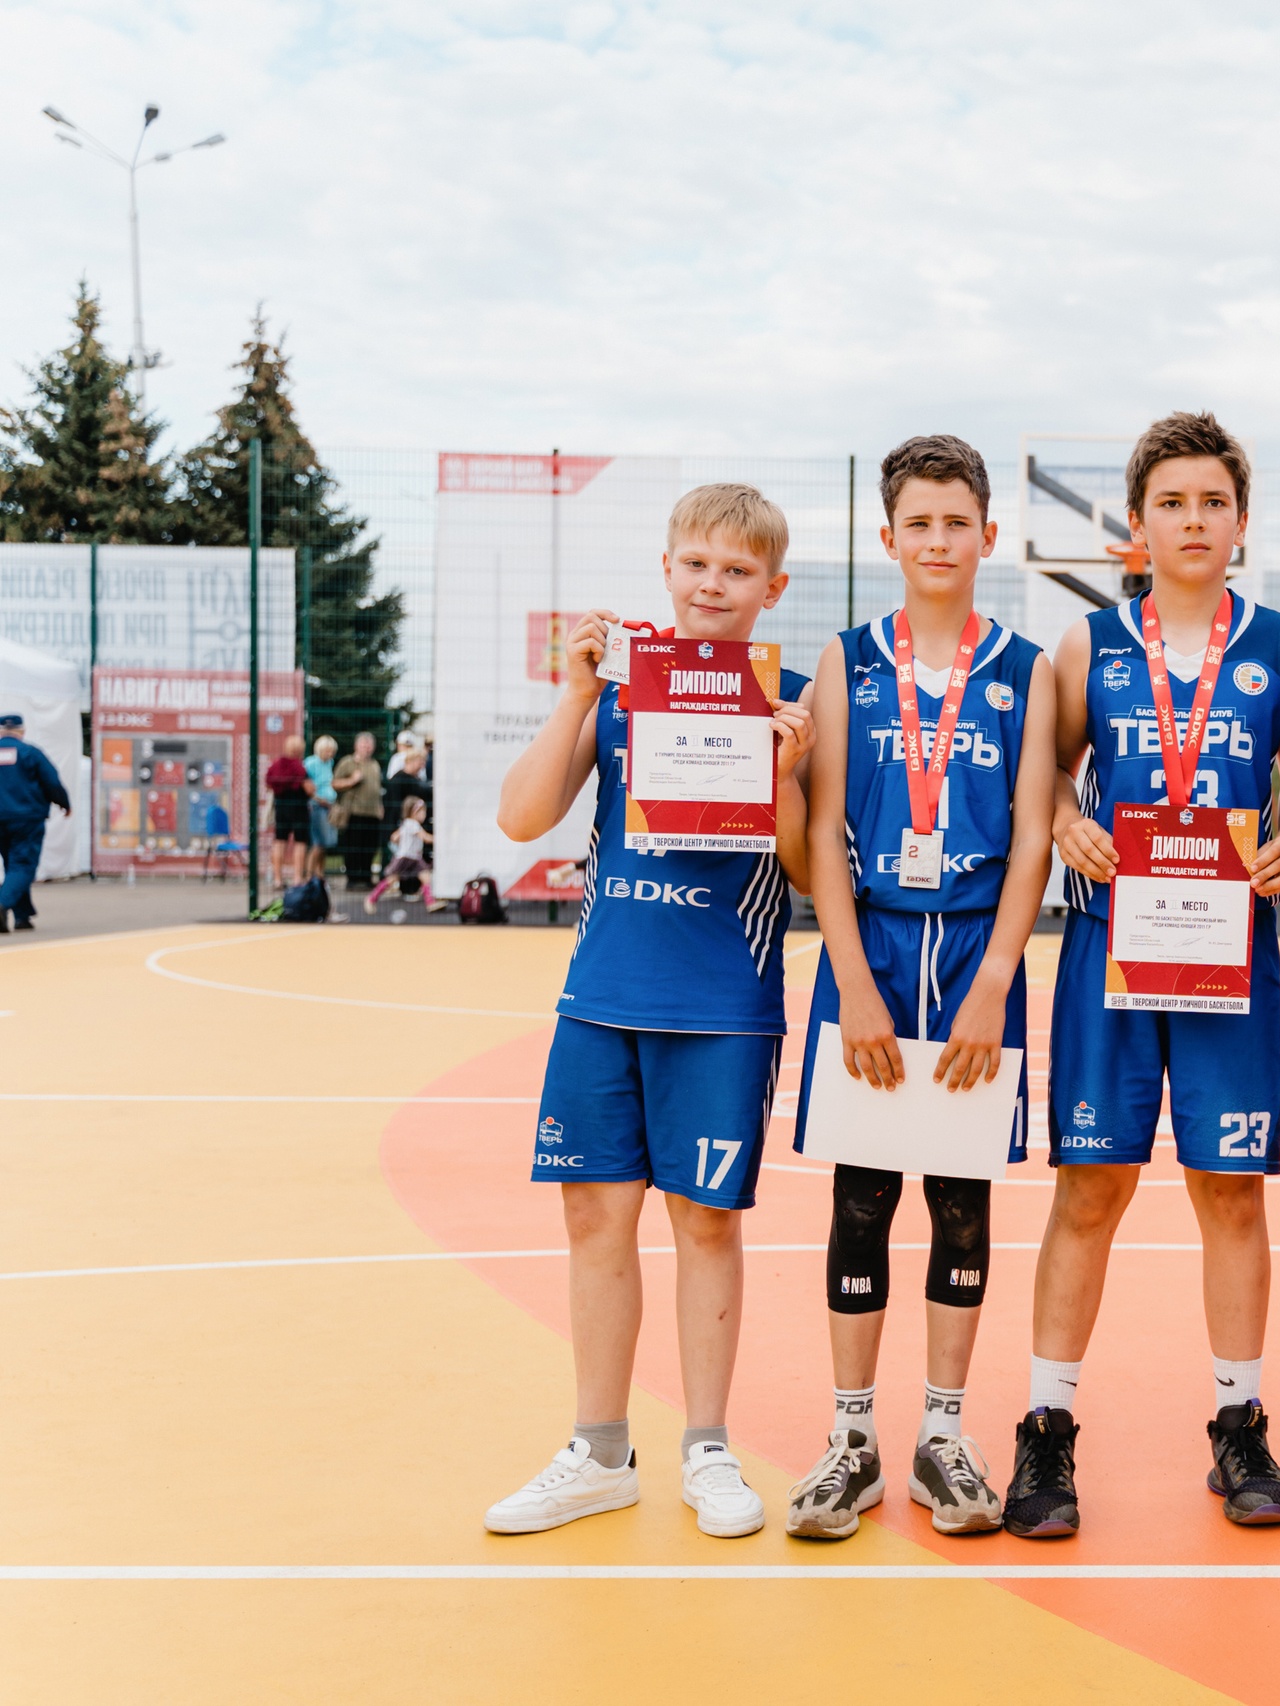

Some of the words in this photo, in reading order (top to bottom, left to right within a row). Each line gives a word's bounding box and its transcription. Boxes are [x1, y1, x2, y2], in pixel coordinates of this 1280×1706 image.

[612, 637, 623, 652] 2
[651, 645, 676, 653] DKC
[669, 670, 741, 696] ДИПЛОМ
[1103, 679, 1130, 688] ТВЕРЬ
[99, 677, 209, 709] НАВИГАЦИЯ
[670, 701, 719, 712] НАГРАЖДАЕТСЯ
[720, 703, 741, 712] ИГРОК
[855, 697, 880, 705] ТВЕРЬ
[1160, 704, 1172, 734] DKC
[1210, 709, 1233, 718] КЛУБ
[676, 736, 687, 746] ЗА
[704, 737, 732, 748] МЕСТО
[1109, 718, 1253, 760] ТВЕРЬ
[1188, 722, 1201, 749] DKC
[871, 729, 1000, 768] ТВЕРЬ
[907, 729, 919, 758] DKC
[932, 745, 946, 773] DKC
[1134, 811, 1158, 819] DKC
[654, 836, 682, 847] ТВЕРСКОЙ
[684, 838, 702, 848] ЦЕНТР
[704, 838, 734, 848] УЛИЧНОГО
[735, 839, 770, 849] БАСКЕТБОЛА
[1150, 835, 1219, 861] ДИПЛОМ
[908, 845, 919, 858] 2
[943, 853, 986, 873] KC
[1151, 866, 1198, 876] НАГРАЖДАЕТСЯ
[1199, 868, 1217, 877] ИГРОК
[633, 879, 712, 908] DKC
[1155, 899, 1166, 910] ЗА
[1182, 901, 1208, 911] МЕСТО
[1132, 997, 1160, 1008] ТВЕРСКОЙ
[1161, 998, 1178, 1009] ЦЕНТР
[1179, 998, 1208, 1009] УЛИЧНОГО
[1209, 999, 1244, 1011] БАСКЕТБОЛА
[1073, 1118, 1096, 1127] ТВЕРЬ
[539, 1134, 563, 1143] ТВЕРЬ
[1219, 1111, 1271, 1158] 23
[1072, 1136, 1113, 1149] DKC
[537, 1153, 584, 1167] DKC
[695, 1137, 743, 1190] 17
[851, 1276, 872, 1294] NBA
[960, 1269, 980, 1287] NBA
